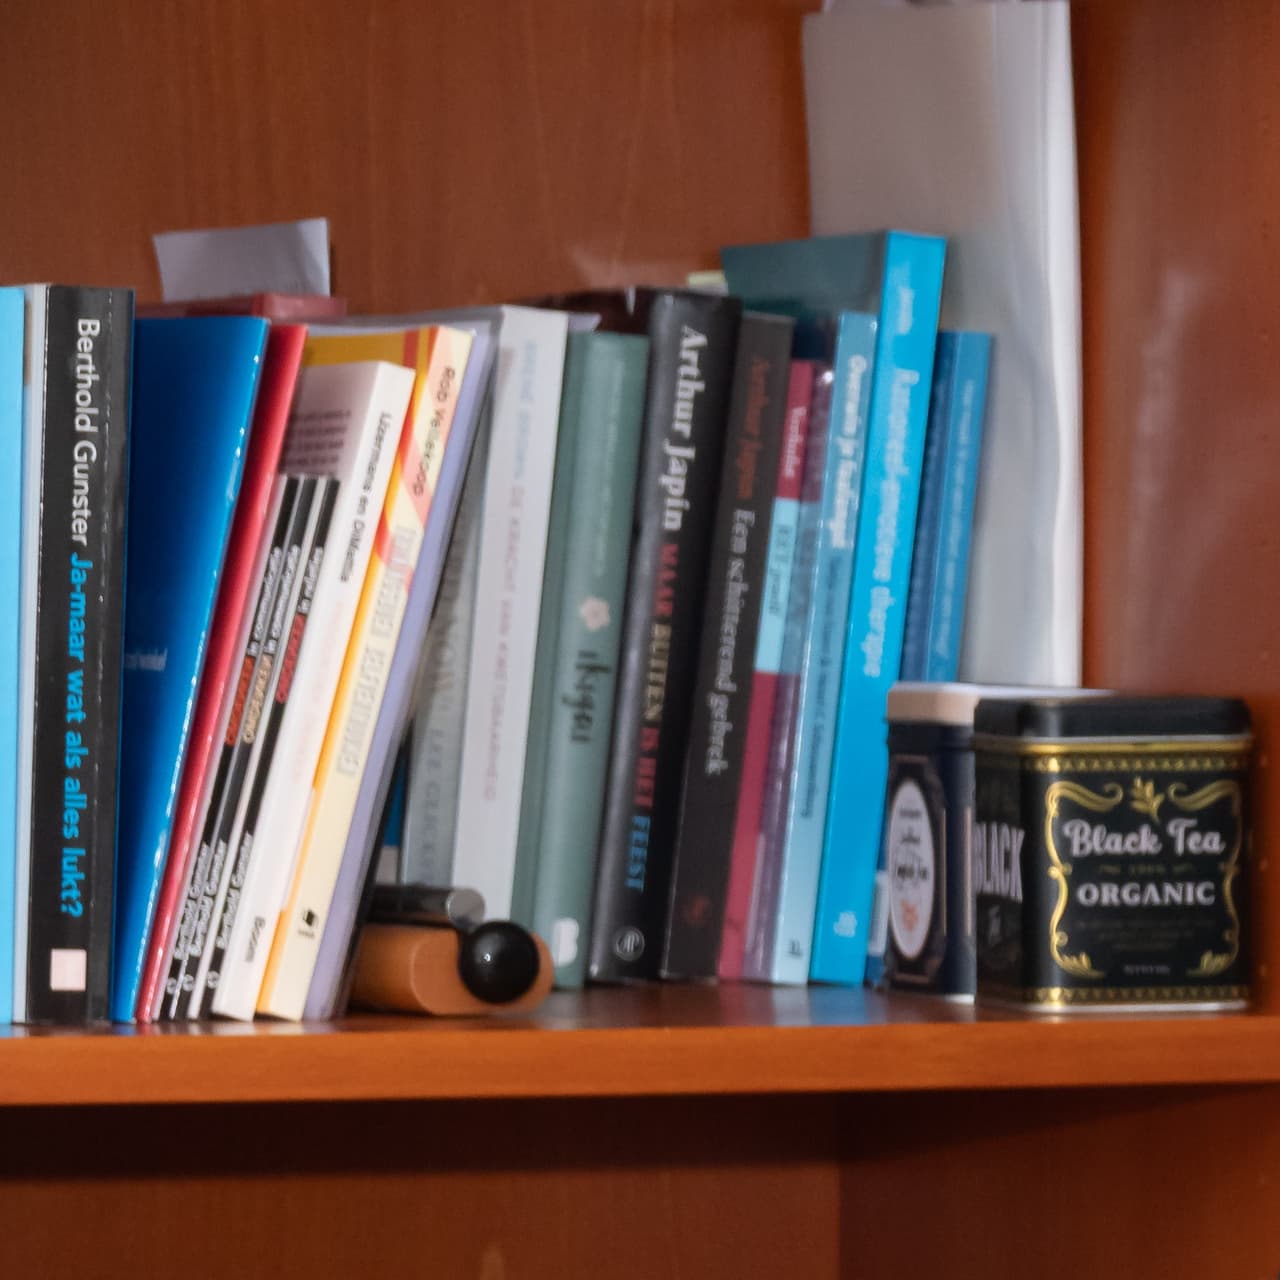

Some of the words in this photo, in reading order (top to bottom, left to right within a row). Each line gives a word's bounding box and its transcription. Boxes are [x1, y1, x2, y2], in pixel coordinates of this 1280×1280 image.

[73, 317, 101, 431] Berthold
[672, 325, 708, 438] Arthur
[70, 438, 99, 546] Gunster
[658, 438, 697, 532] Japin
[66, 551, 94, 663] Ja-maar
[66, 669, 88, 724] wat
[65, 731, 90, 769] als
[63, 776, 88, 839] alles
[1062, 818, 1163, 858] Black
[1166, 818, 1227, 857] Tea
[60, 847, 87, 919] lukt?
[625, 815, 652, 895] FEEST
[1076, 881, 1216, 907] ORGANIC
